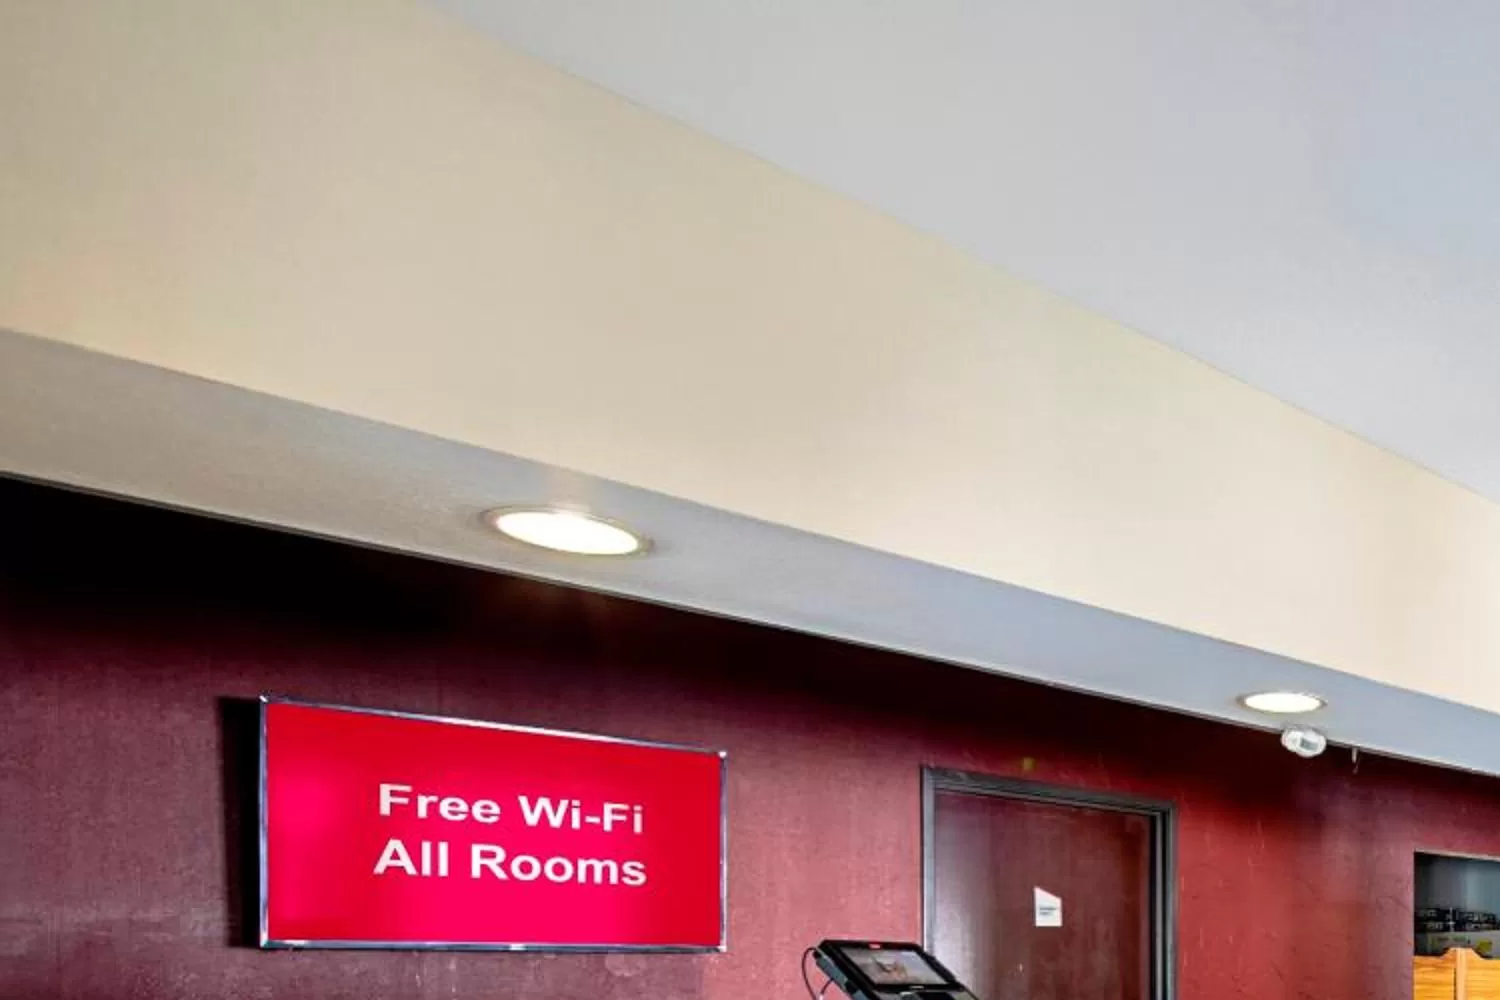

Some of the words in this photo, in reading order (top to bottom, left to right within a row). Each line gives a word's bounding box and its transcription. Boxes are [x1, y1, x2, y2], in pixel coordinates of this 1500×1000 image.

[379, 783, 501, 824] Free
[517, 795, 644, 835] Wi-Fi
[373, 838, 449, 877] All
[470, 843, 647, 887] Rooms
